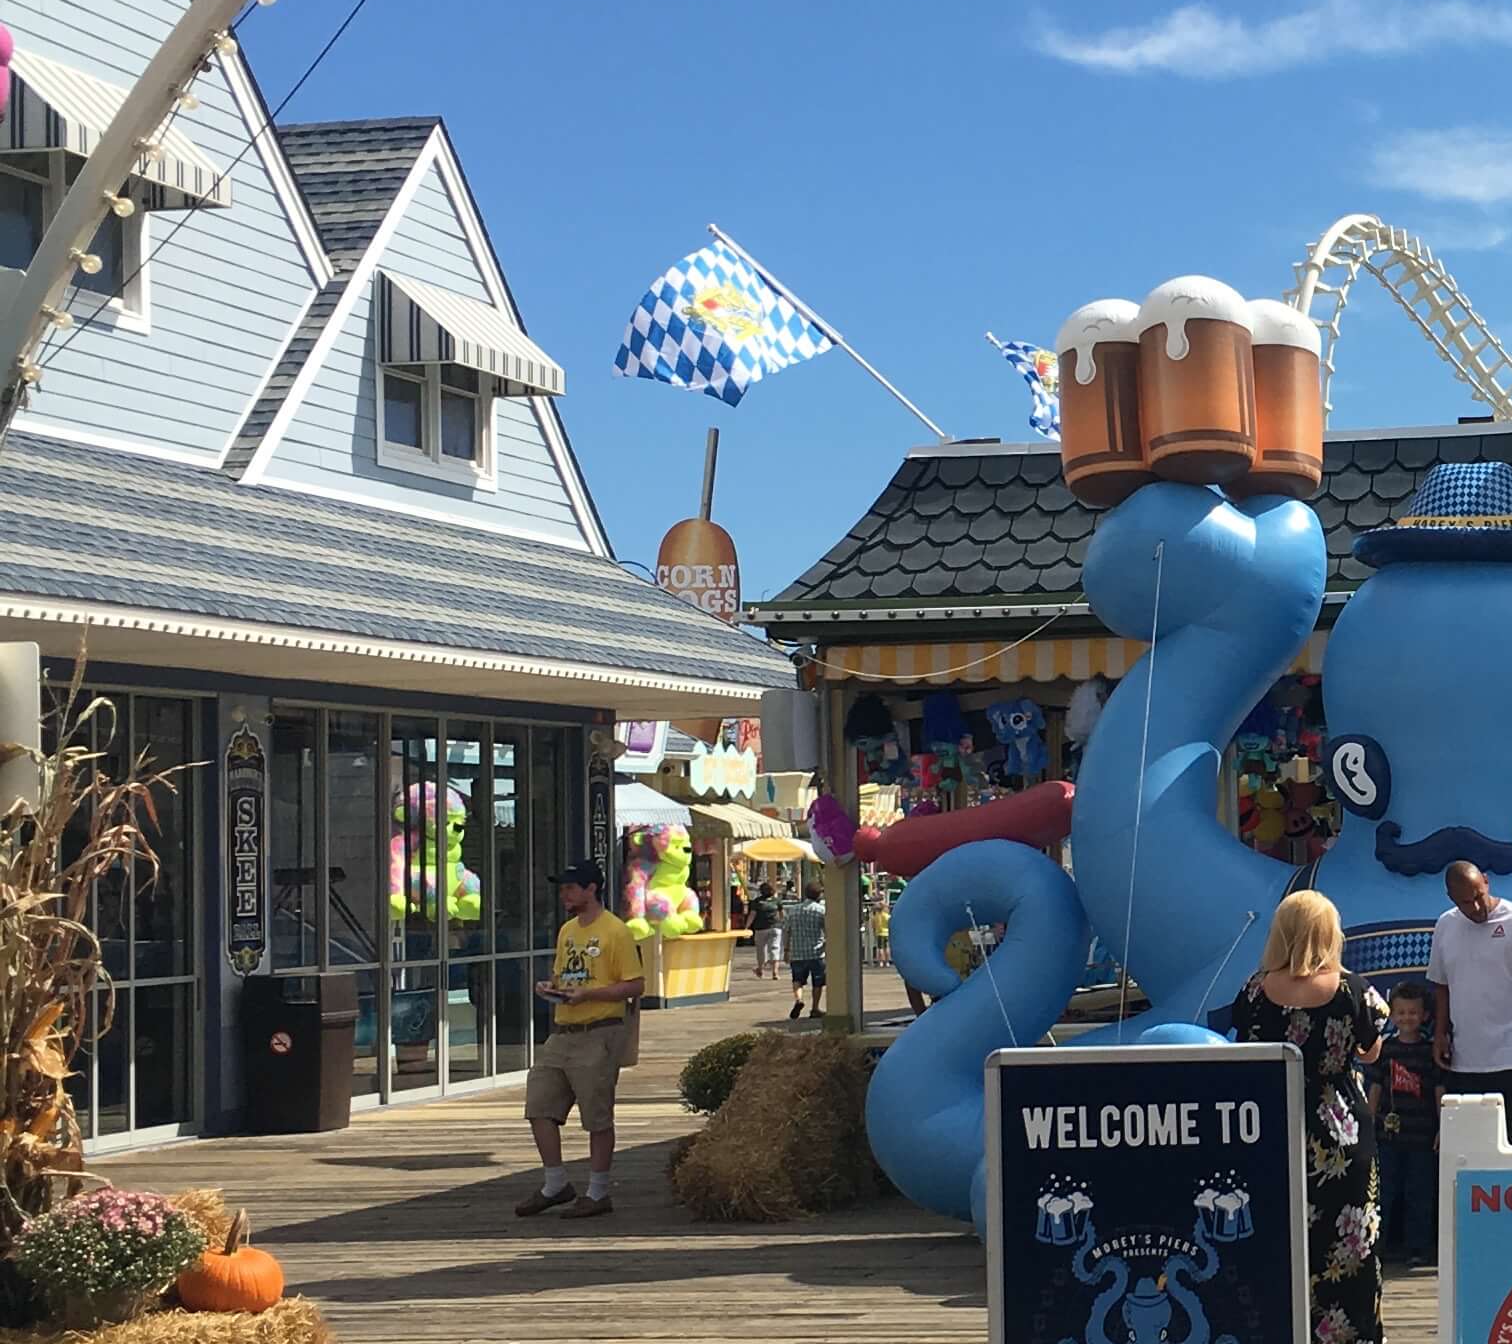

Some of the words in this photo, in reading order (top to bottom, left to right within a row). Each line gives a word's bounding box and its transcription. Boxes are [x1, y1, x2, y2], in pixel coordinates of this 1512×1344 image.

[657, 565, 736, 588] CORN
[677, 590, 737, 613] OGS
[235, 797, 257, 916] SKEE
[1022, 1103, 1200, 1149] WELCOME
[1215, 1101, 1260, 1144] TO
[1092, 1235, 1152, 1259] MOREY'S
[1160, 1235, 1199, 1256] PIERS
[1123, 1248, 1168, 1258] PRESENTS
